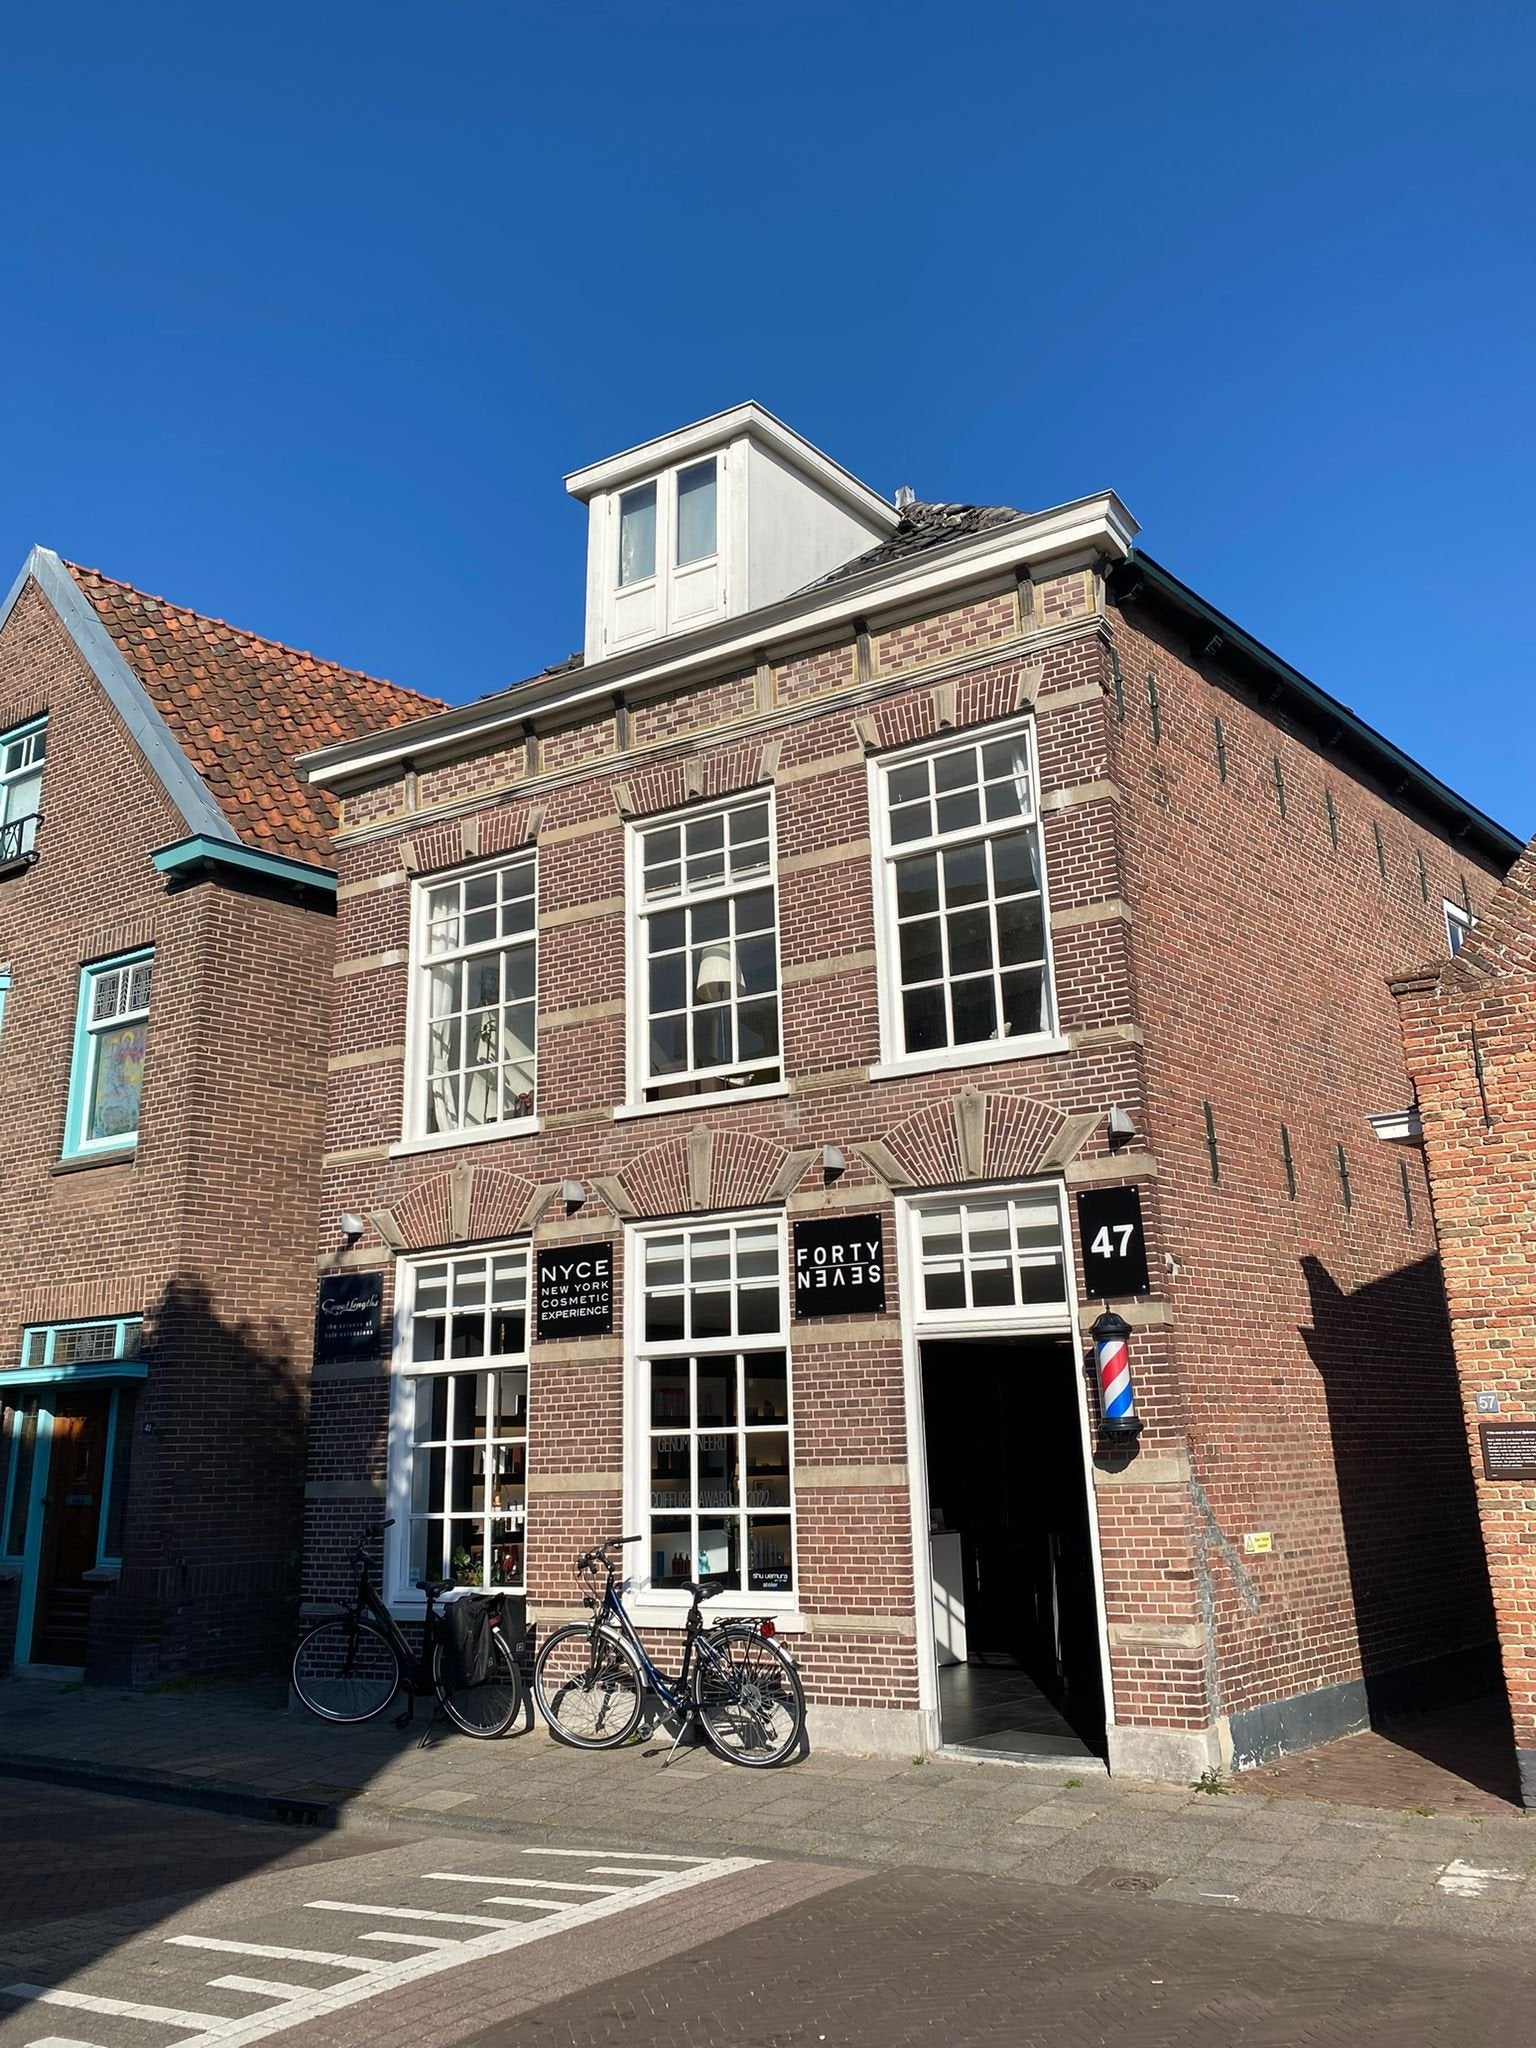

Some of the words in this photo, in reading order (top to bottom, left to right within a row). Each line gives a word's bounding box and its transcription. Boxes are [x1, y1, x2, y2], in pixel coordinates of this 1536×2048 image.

[1091, 1224, 1134, 1258] 47
[797, 1241, 879, 1267] FORTY
[542, 1259, 609, 1283] NYCE
[541, 1285, 569, 1296] NEW
[574, 1280, 609, 1292] YORK
[541, 1293, 609, 1308] COSMETIC
[541, 1305, 609, 1320] EXPERIENCE
[1479, 1395, 1496, 1409] 57
[658, 1434, 727, 1453] GENOMNEERD
